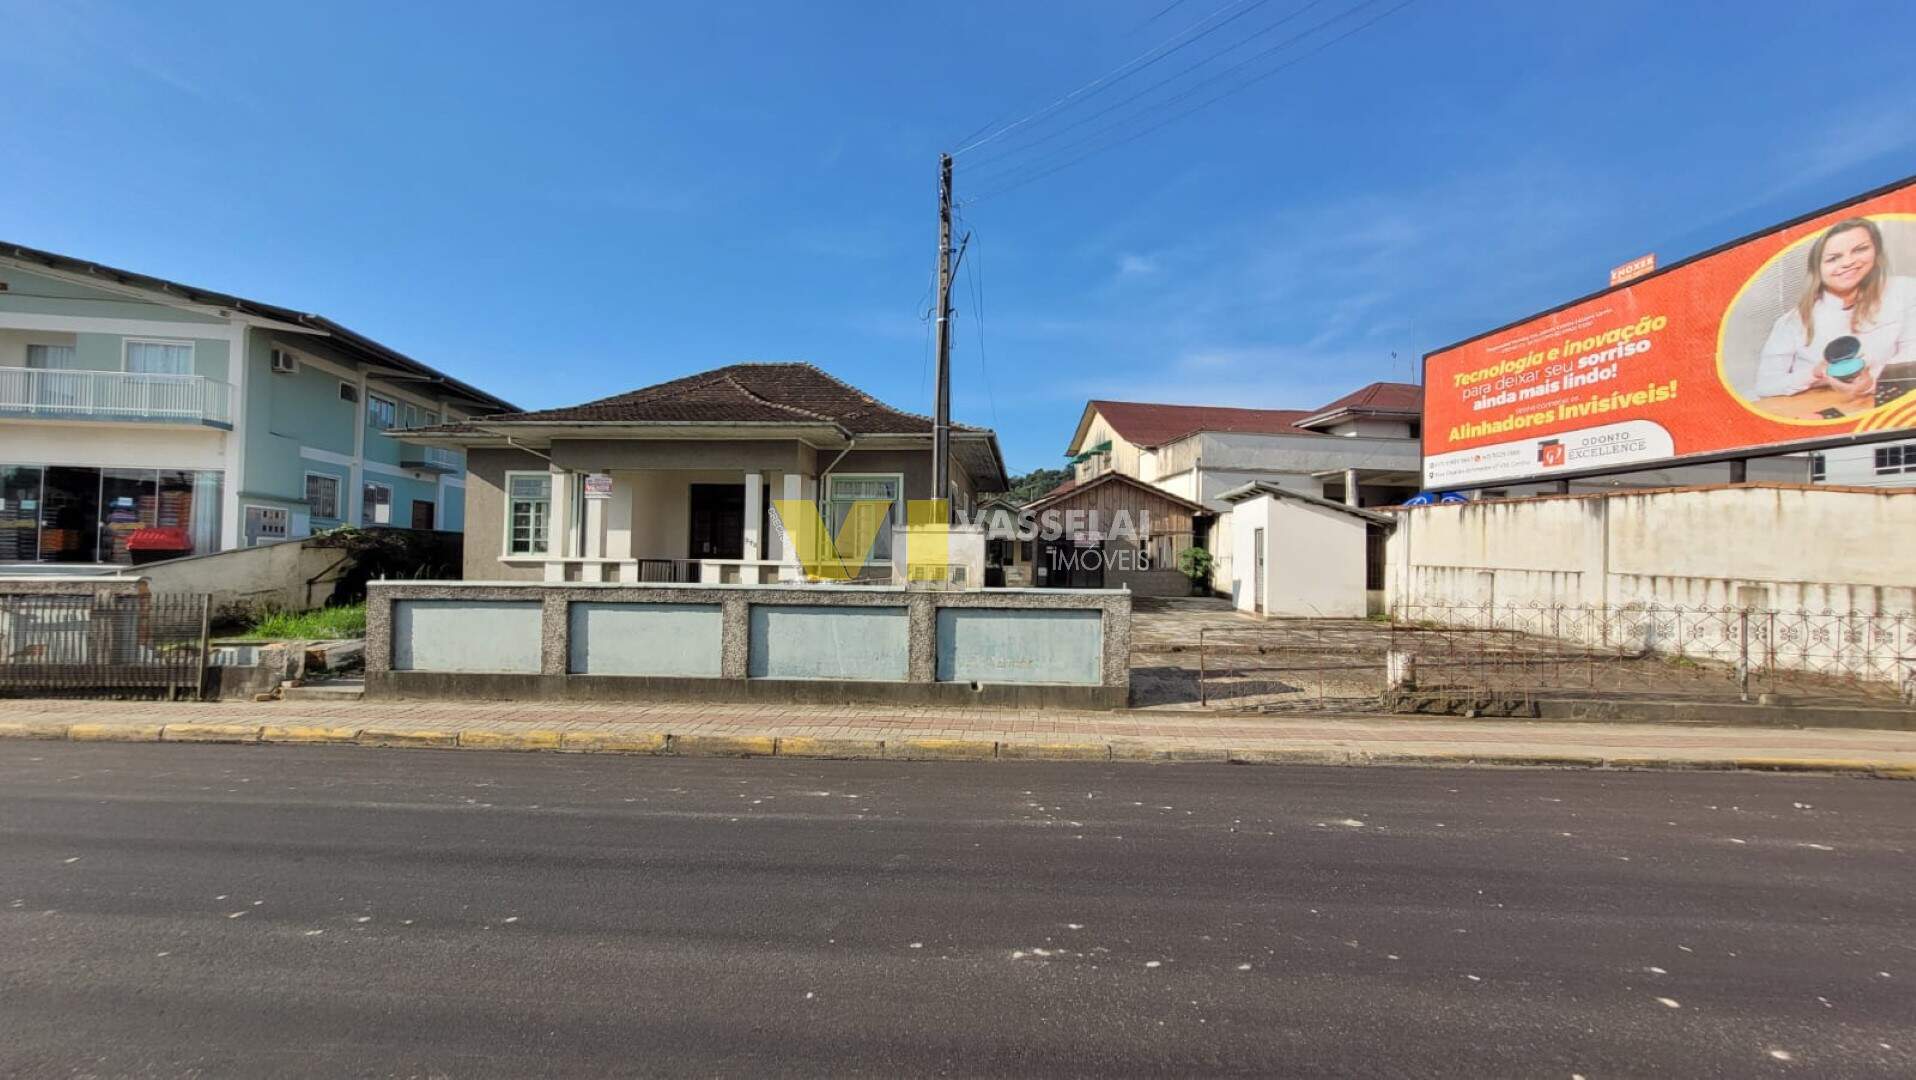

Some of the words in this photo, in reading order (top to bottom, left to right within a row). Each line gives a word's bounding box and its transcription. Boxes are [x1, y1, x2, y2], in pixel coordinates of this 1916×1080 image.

[1454, 350, 1544, 387] Tecnologia
[1547, 346, 1560, 361] e
[1563, 314, 1668, 357] inovação
[1463, 382, 1491, 400] para
[1495, 371, 1540, 391] deixar
[1544, 361, 1574, 378] seu
[1577, 338, 1652, 370] sorriso
[1449, 409, 1555, 442] Alinhadores
[1558, 379, 1678, 421] Invisíveis!
[1473, 390, 1517, 411] ainda
[1519, 380, 1560, 400] mais
[1563, 363, 1618, 391] lindo!
[1568, 440, 1648, 461] EXCELLENCE
[1582, 431, 1630, 446] ODONTO
